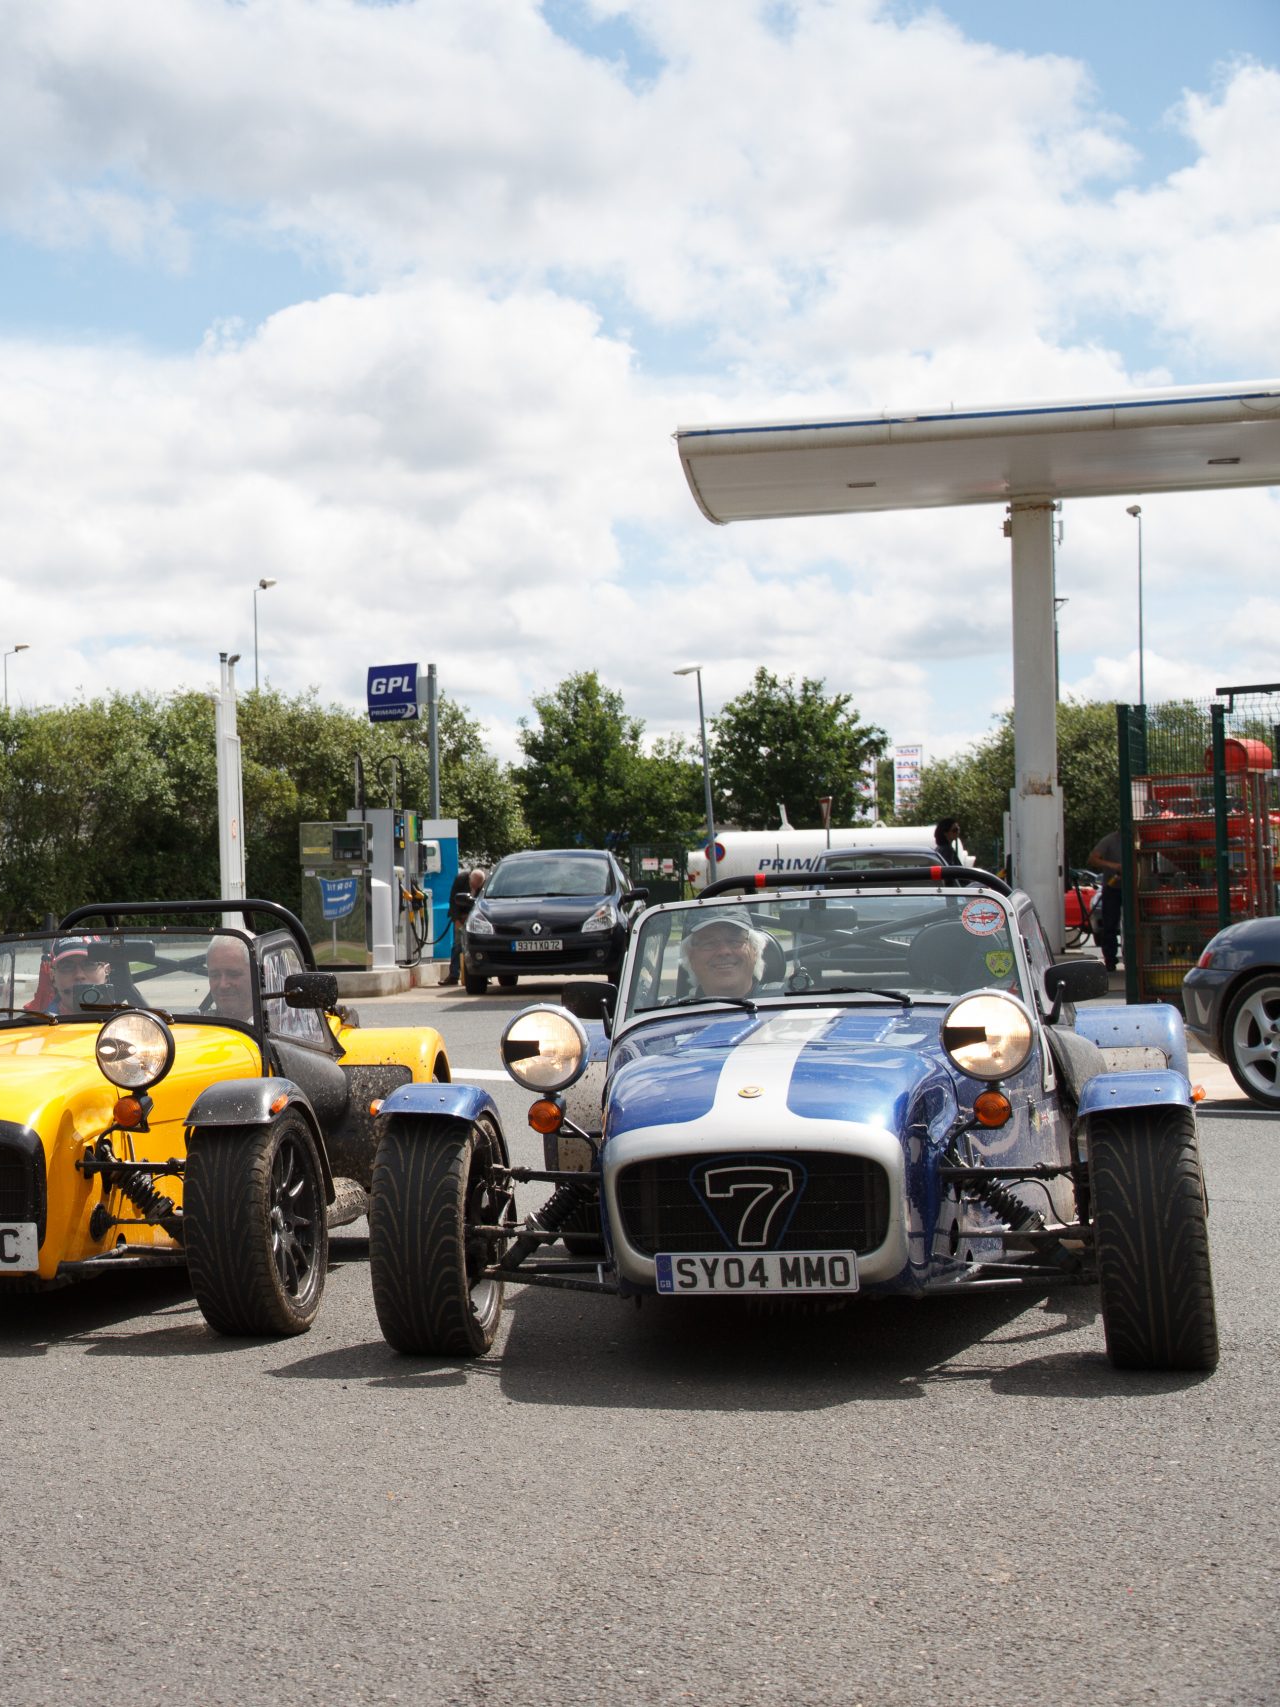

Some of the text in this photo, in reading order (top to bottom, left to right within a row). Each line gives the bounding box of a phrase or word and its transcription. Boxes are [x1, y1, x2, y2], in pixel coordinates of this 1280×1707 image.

[371, 676, 413, 695] GPL
[705, 1165, 794, 1246] 7
[659, 1279, 672, 1289] GB
[676, 1255, 851, 1289] SY04 MMO
